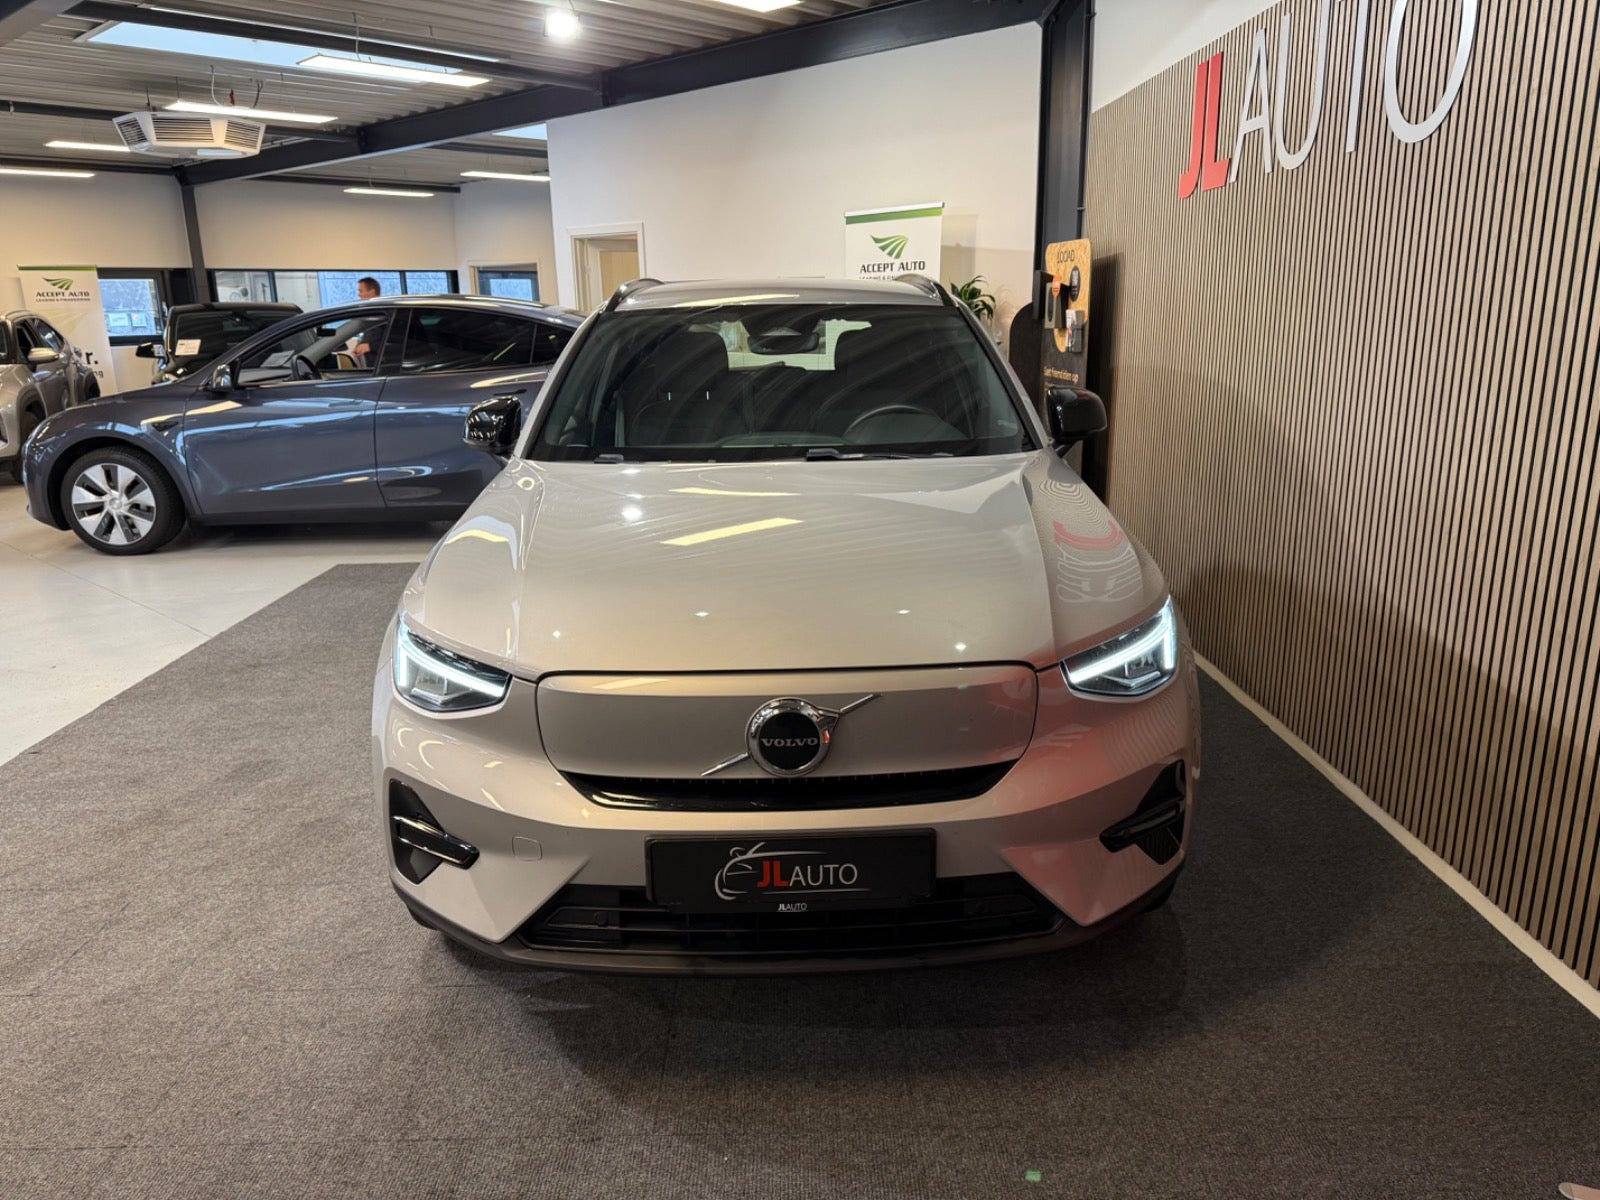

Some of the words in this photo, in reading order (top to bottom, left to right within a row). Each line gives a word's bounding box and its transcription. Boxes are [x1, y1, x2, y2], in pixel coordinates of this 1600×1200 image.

[1178, 0, 1479, 200] JLAUTO
[860, 262, 895, 273] ACCEPT
[897, 260, 926, 271] AUTO
[760, 737, 818, 747] VOLVO
[757, 860, 858, 889] JLAUTO
[778, 903, 808, 912] JLAUTO
